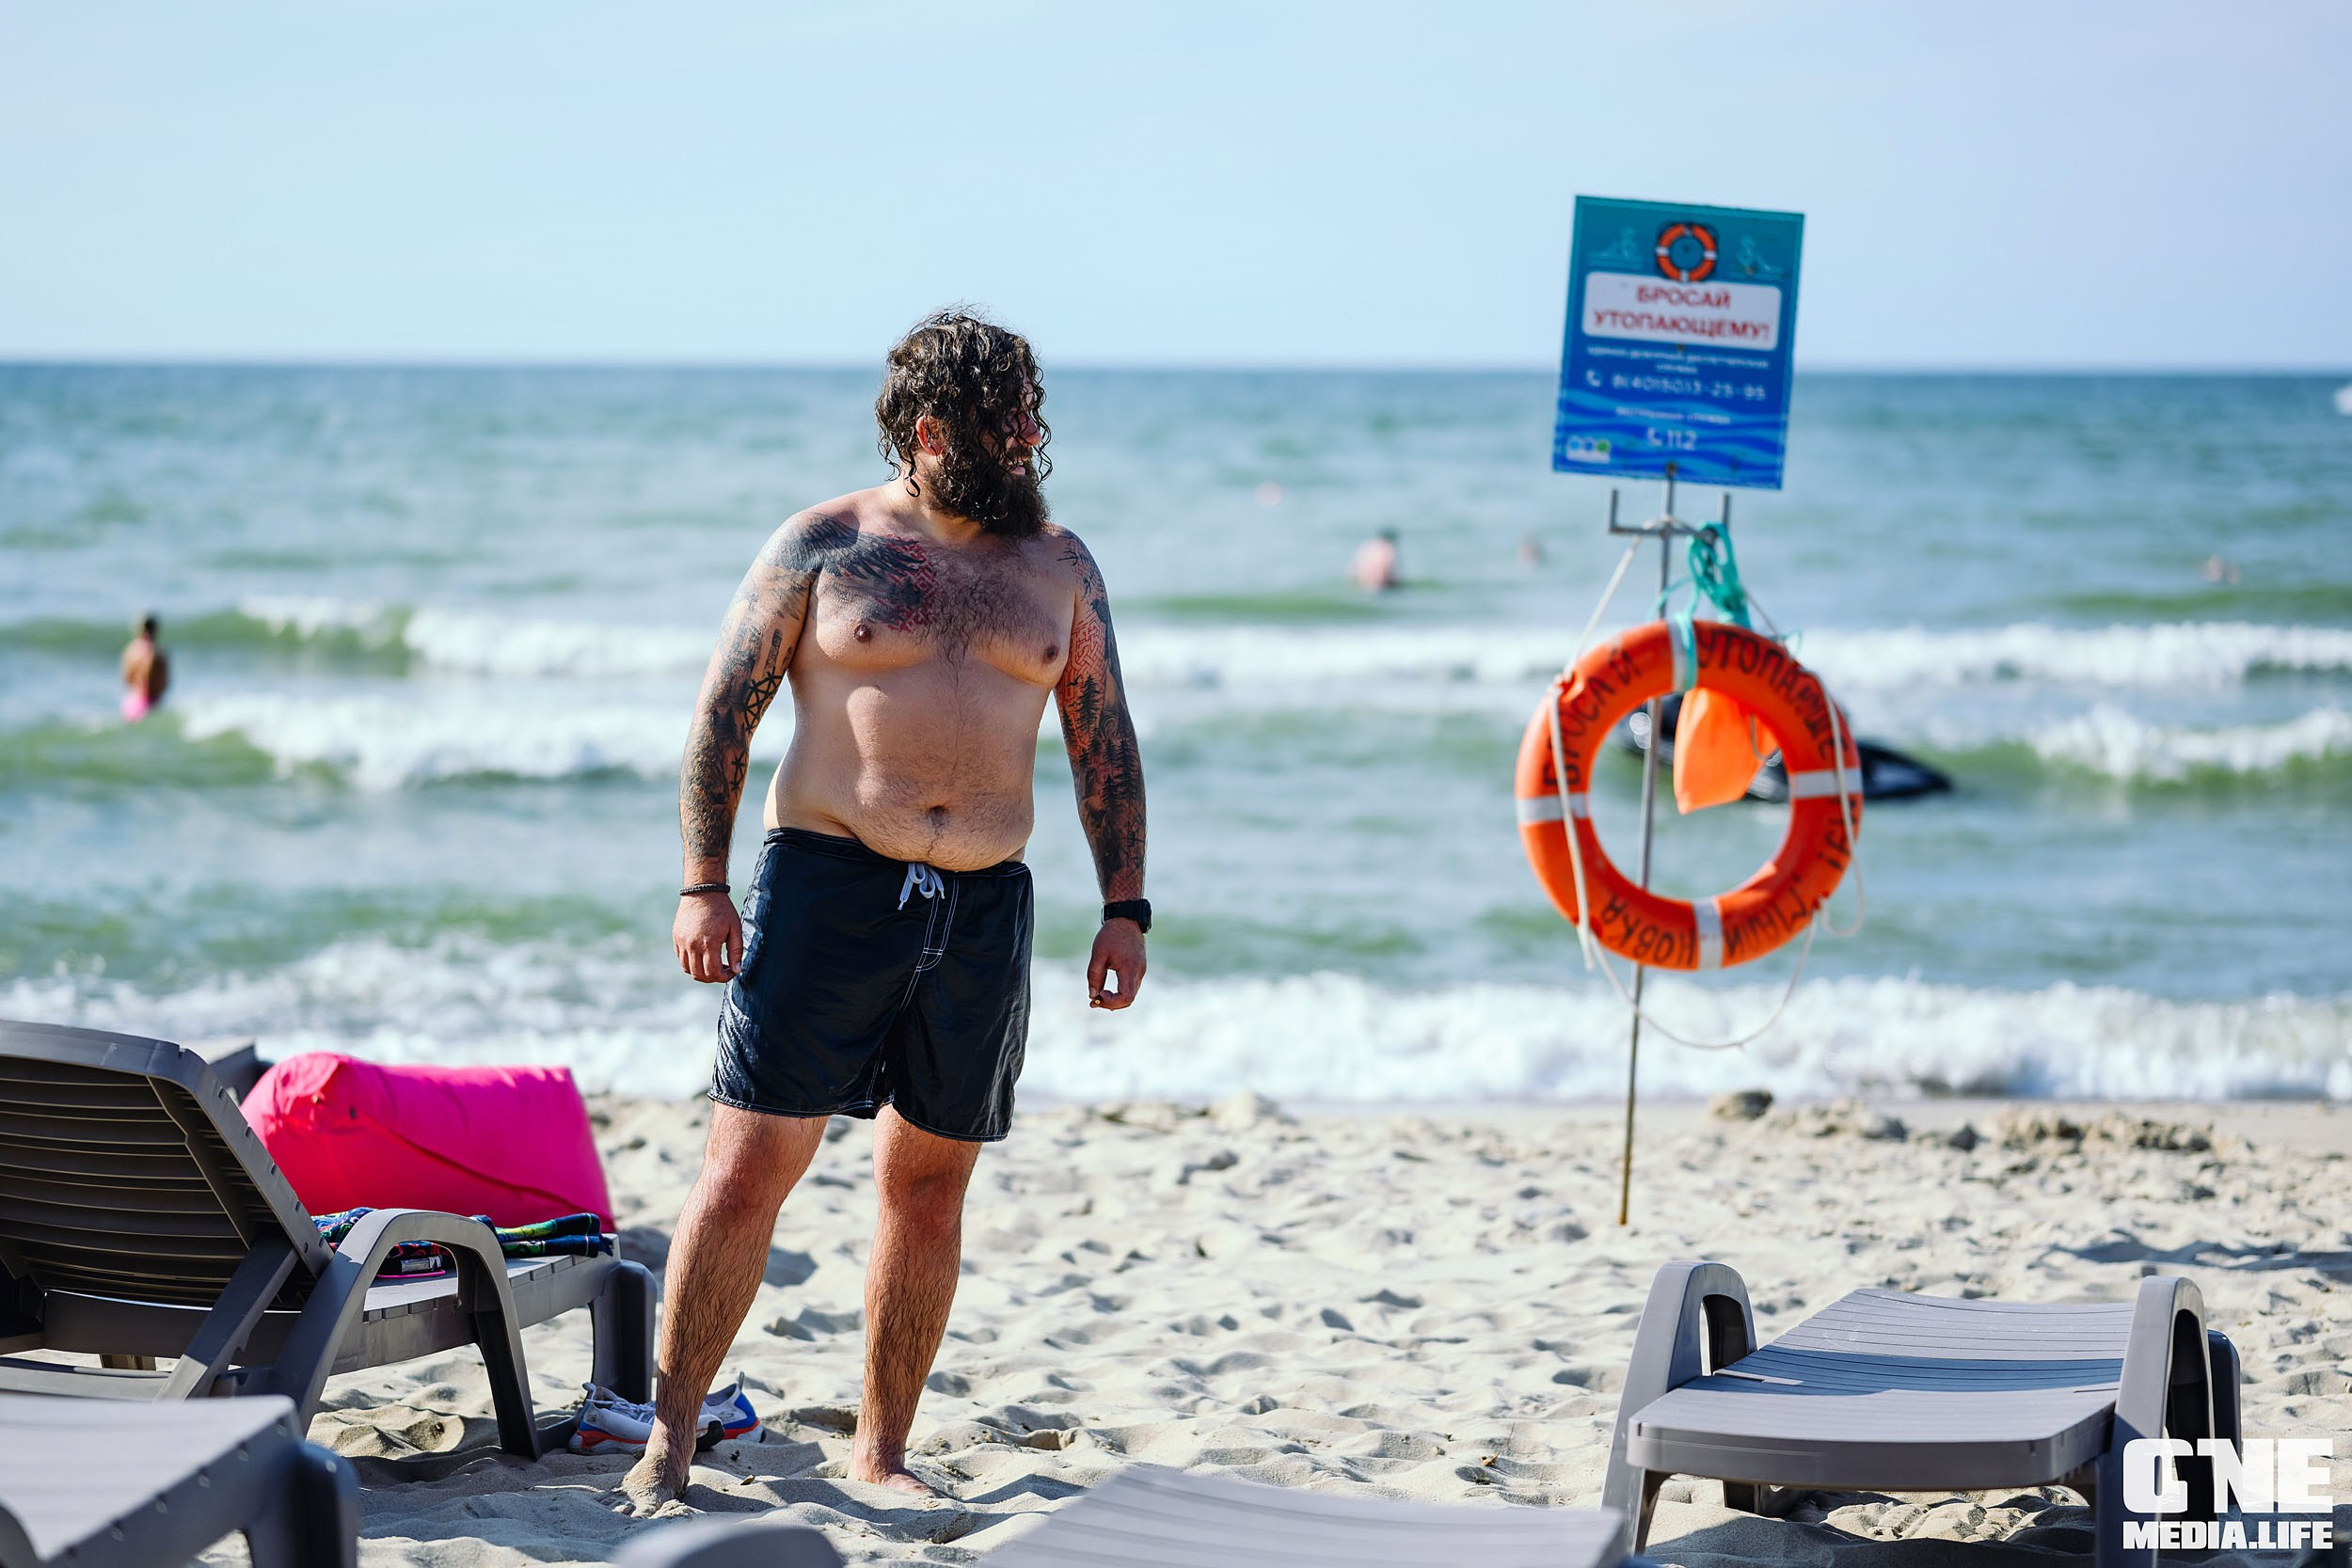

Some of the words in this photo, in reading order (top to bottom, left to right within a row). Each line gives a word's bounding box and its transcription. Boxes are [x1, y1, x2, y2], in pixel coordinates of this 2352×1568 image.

[1637, 285, 1731, 309] БРОСАЙ
[1593, 310, 1770, 340] УТОПАЮЩЕМУ!
[1667, 429, 1697, 451] 112
